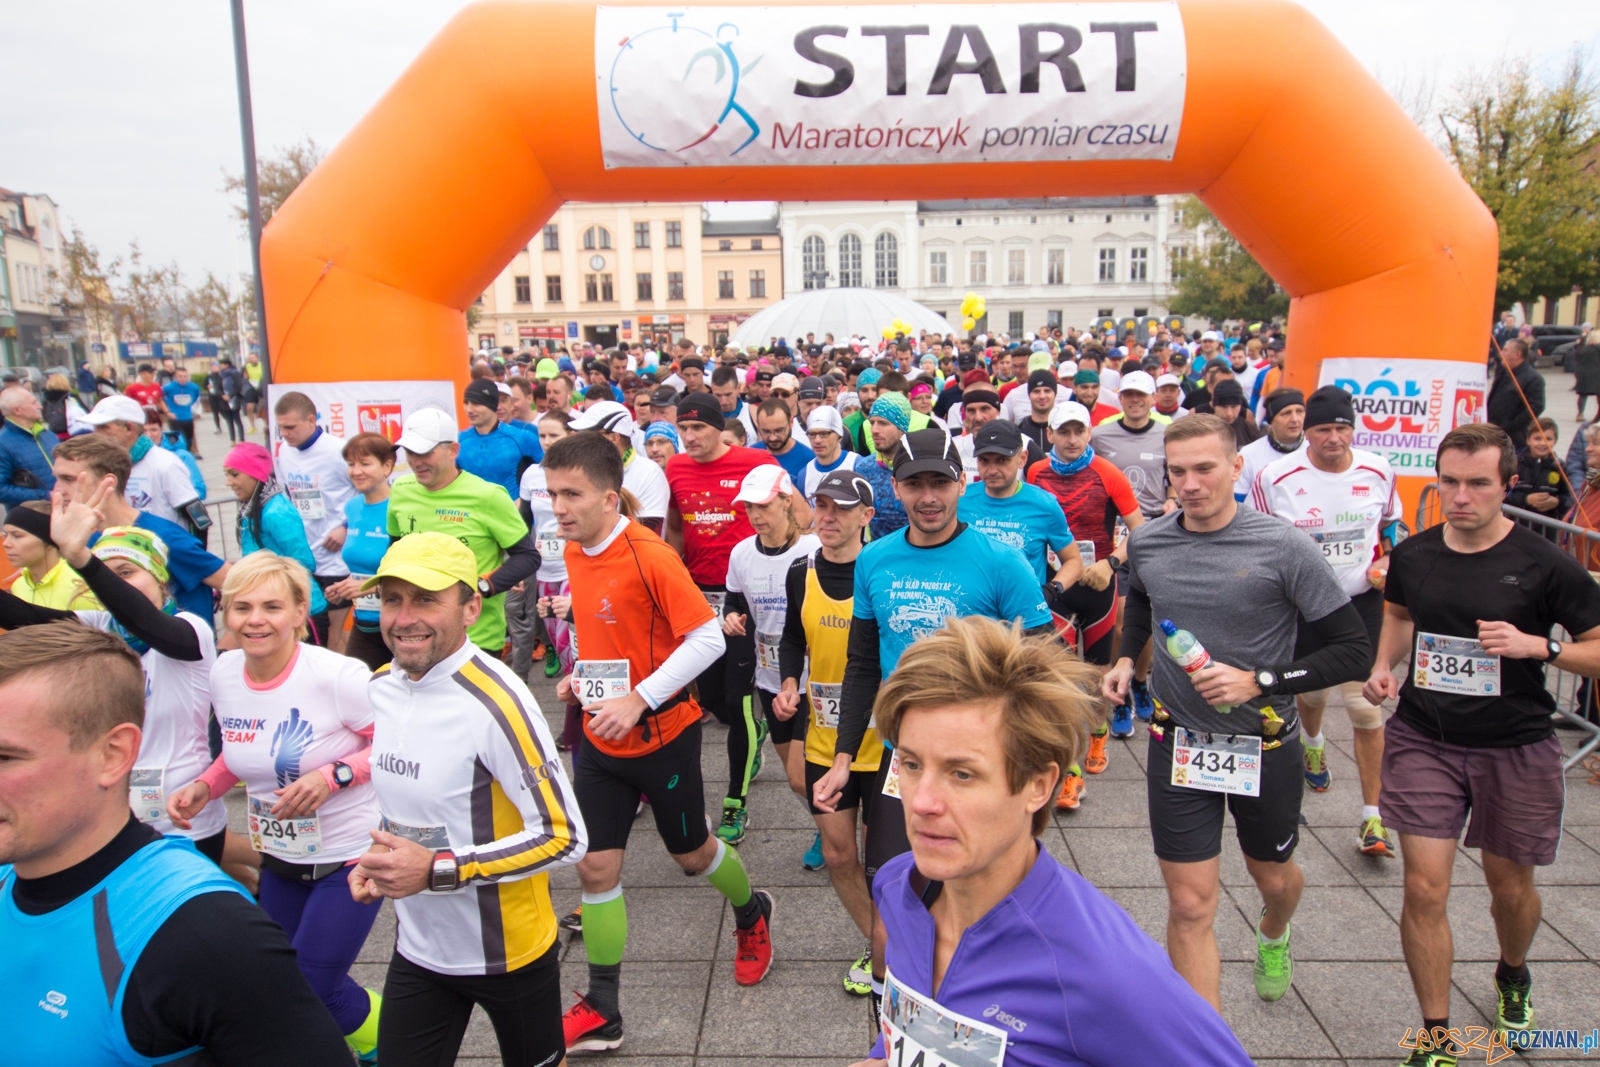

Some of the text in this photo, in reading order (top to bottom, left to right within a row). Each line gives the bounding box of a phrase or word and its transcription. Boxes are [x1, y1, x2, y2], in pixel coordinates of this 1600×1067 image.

[793, 21, 1158, 98] START
[771, 117, 1169, 154] Maratończyk pomiarczasu
[1353, 398, 1427, 416] ARATON
[1427, 379, 1445, 433] SKOKI
[329, 402, 345, 439] KOKI
[1352, 432, 1439, 450] GROWIEC
[435, 508, 470, 518] HERNIK
[438, 515, 464, 523] TEAM
[1335, 511, 1365, 525] plus
[1295, 519, 1324, 527] ORLEN
[546, 540, 559, 551] 13
[1322, 542, 1353, 557] 515
[921, 581, 952, 591] POZOSTAŁ
[751, 596, 787, 605] Lekkoatle
[1431, 654, 1476, 678] 384
[1441, 676, 1463, 685] Marcin
[586, 680, 604, 698] 26
[222, 716, 266, 731] HERNIK
[224, 730, 256, 744] TEAM
[1191, 750, 1237, 775] 434
[1200, 773, 1226, 782] Tomasz
[259, 819, 297, 841] 294
[995, 1010, 1027, 1033] asics
